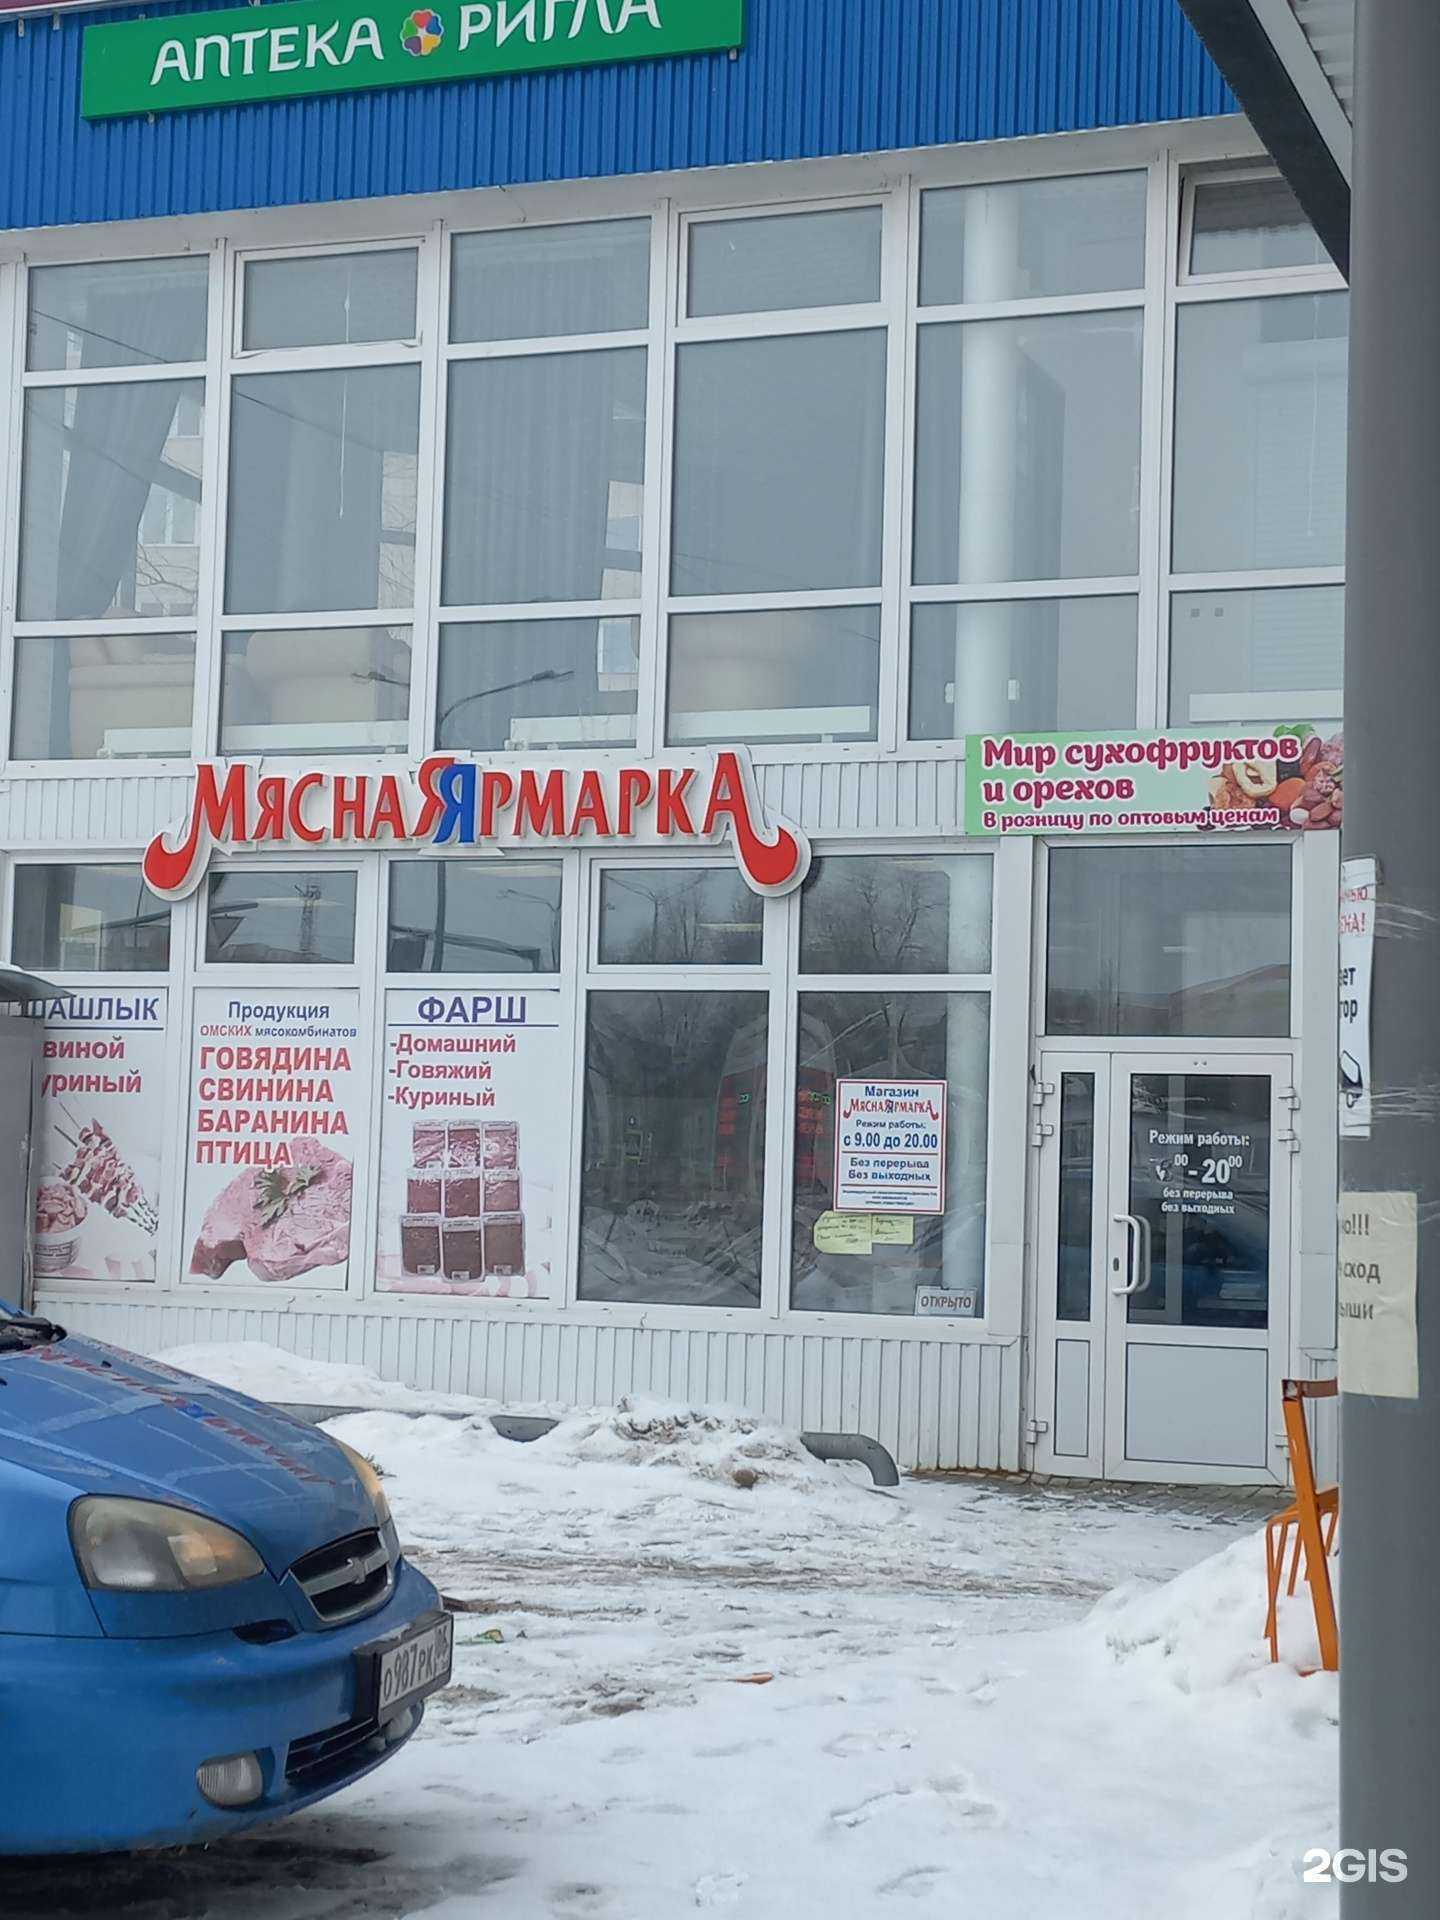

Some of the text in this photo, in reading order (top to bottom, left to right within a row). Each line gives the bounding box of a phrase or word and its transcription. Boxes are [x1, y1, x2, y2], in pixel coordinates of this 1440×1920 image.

[150, 0, 662, 86] АПТЕКА РИГЛА
[983, 737, 1299, 773] Мир сухофруктов
[983, 778, 1135, 808] и орехов
[1002, 811, 1084, 832] розницу
[1090, 813, 1112, 827] по
[1118, 810, 1206, 827] оптовым
[1211, 807, 1279, 828] ценам
[228, 1001, 330, 1022] Продукция
[418, 996, 527, 1023] ФАРШ
[200, 1025, 357, 1037] ОМСКИХ мясокомбинатов
[200, 1046, 351, 1075] ГОВЯДИНА
[198, 1078, 335, 1102] СВИНИНА
[865, 1086, 919, 1097] Магазин
[197, 1109, 349, 1135] БАРАНИНА
[856, 1120, 886, 1128] Режим
[854, 1132, 881, 1147] 9.00
[883, 1136, 901, 1149] до
[904, 1133, 938, 1148] 20.00
[1149, 1130, 1250, 1147] Режим работы:
[196, 1140, 292, 1168] ПТИЦА
[850, 1158, 930, 1170] Без перерыва
[848, 1169, 931, 1181] Без выходных
[1163, 1187, 1234, 1201] без перерыва
[1161, 1201, 1235, 1214] без выходных
[921, 1295, 972, 1310] ОТКРЫТО
